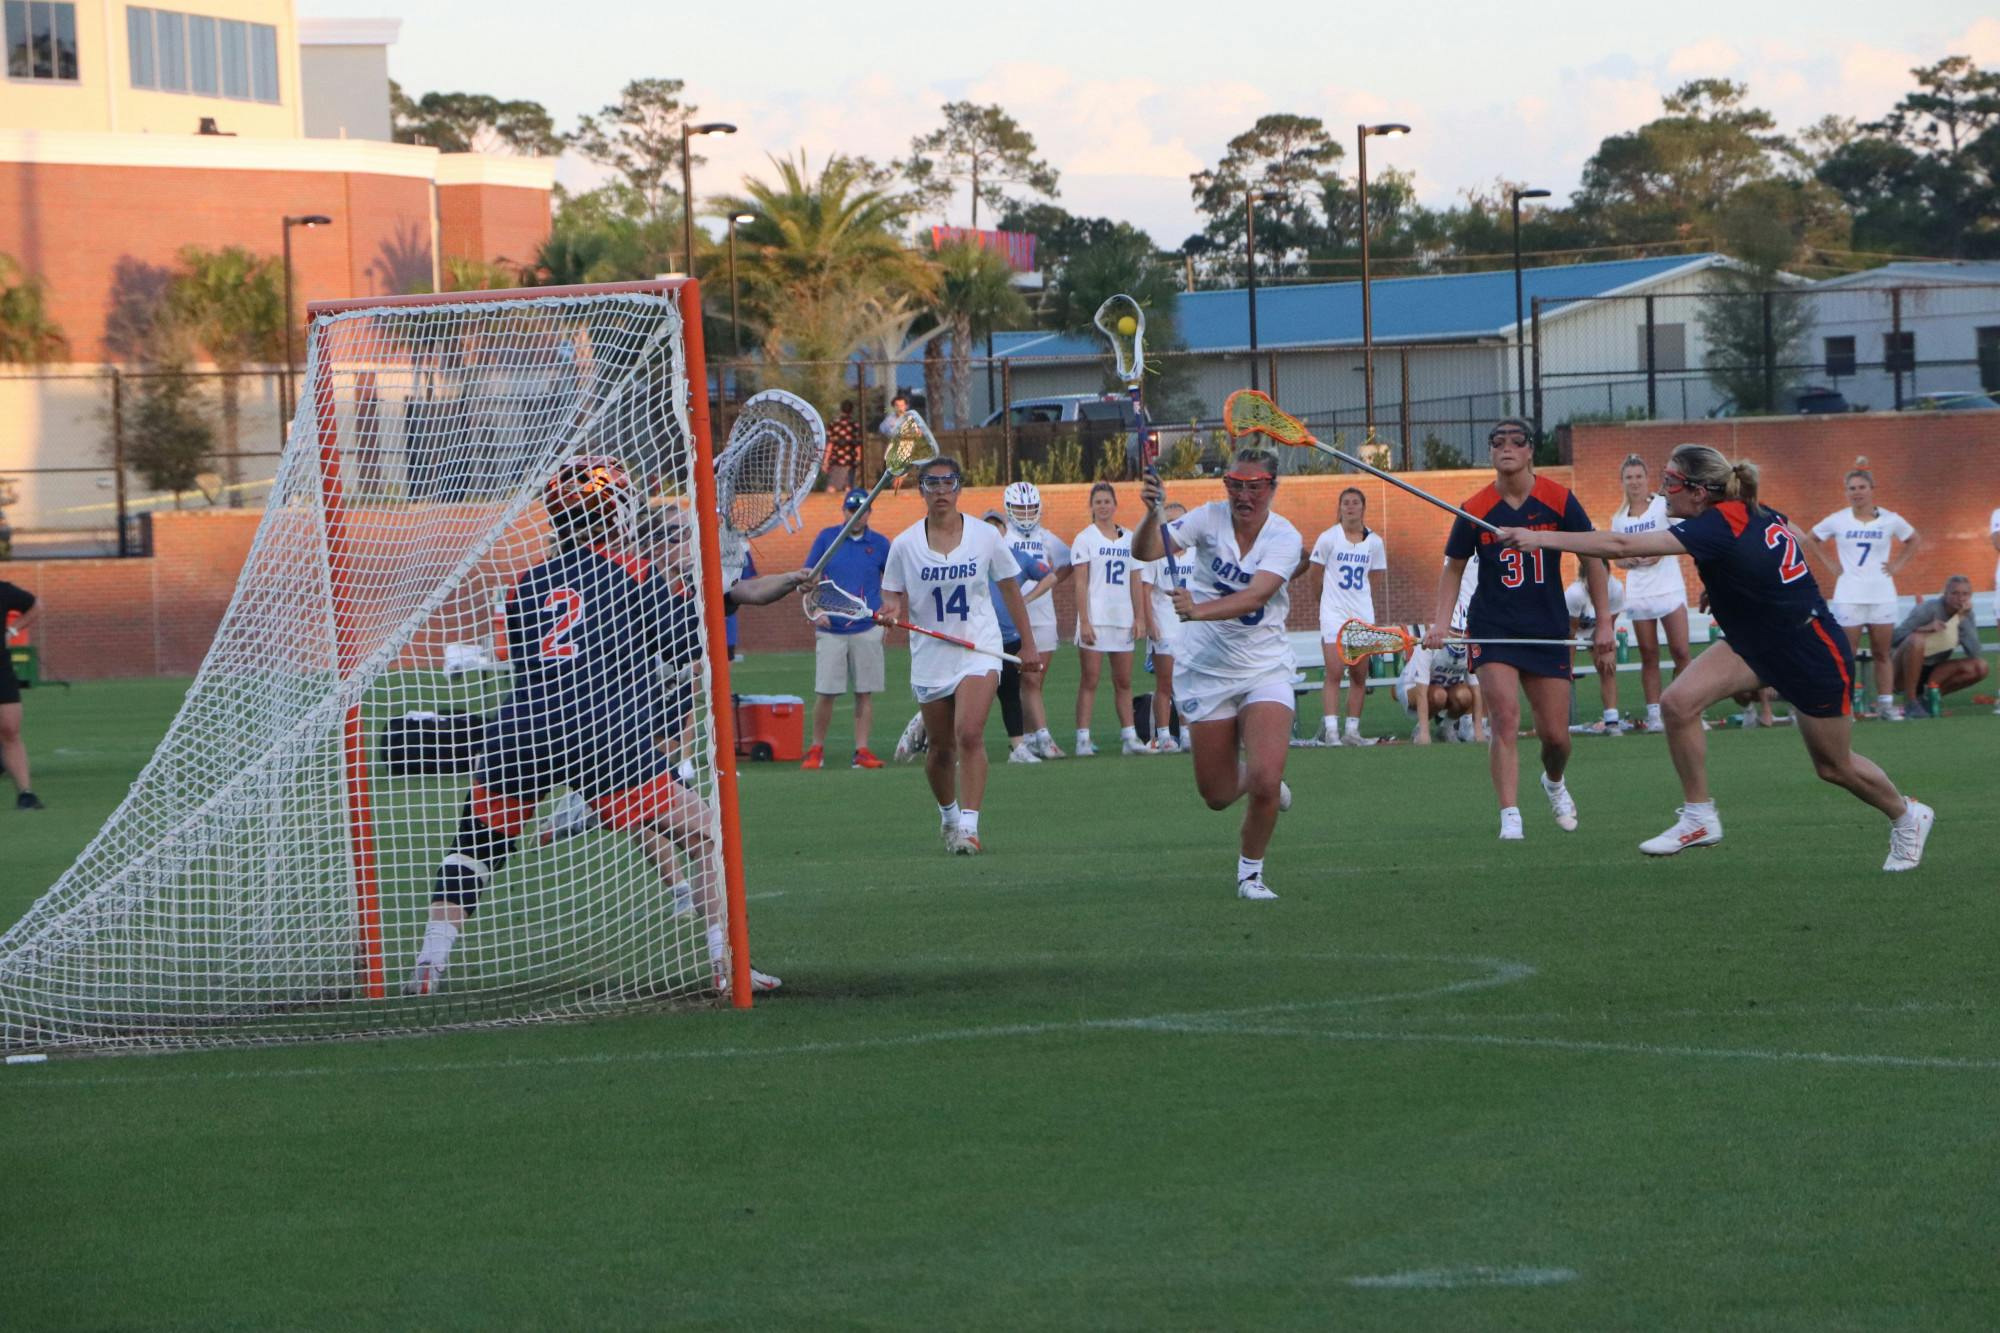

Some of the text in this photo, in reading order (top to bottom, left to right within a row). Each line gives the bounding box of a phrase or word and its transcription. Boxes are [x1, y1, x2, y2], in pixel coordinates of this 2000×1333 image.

[1845, 530, 1883, 539] GATORS
[1856, 542, 1872, 567] 7
[921, 563, 977, 581] GATORS
[1105, 560, 1125, 585] 12
[1338, 565, 1364, 590] 39
[1499, 548, 1545, 588] 31
[932, 584, 970, 622] 14
[540, 588, 583, 660] 2
